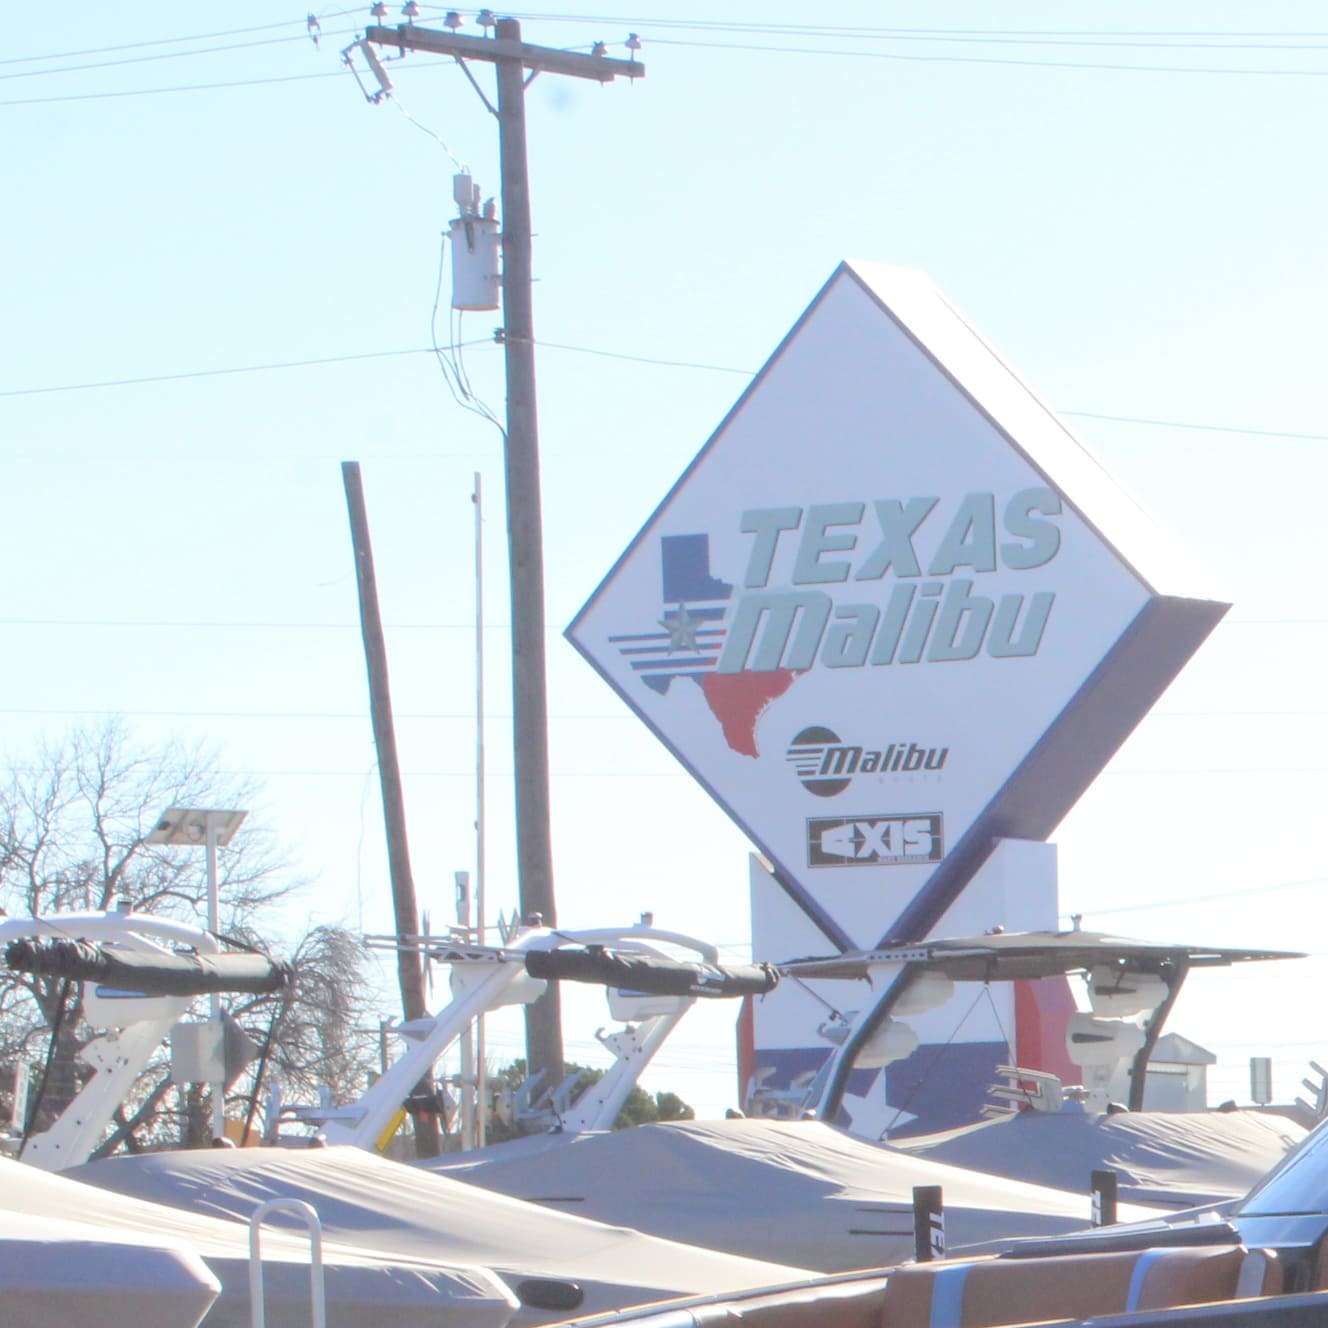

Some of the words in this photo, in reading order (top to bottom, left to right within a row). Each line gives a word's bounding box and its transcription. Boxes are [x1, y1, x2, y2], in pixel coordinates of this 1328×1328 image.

[740, 487, 1062, 589] TEXAS
[716, 579, 1056, 675] Malibu
[819, 743, 949, 775] Malibu
[821, 818, 932, 858] AXIS
